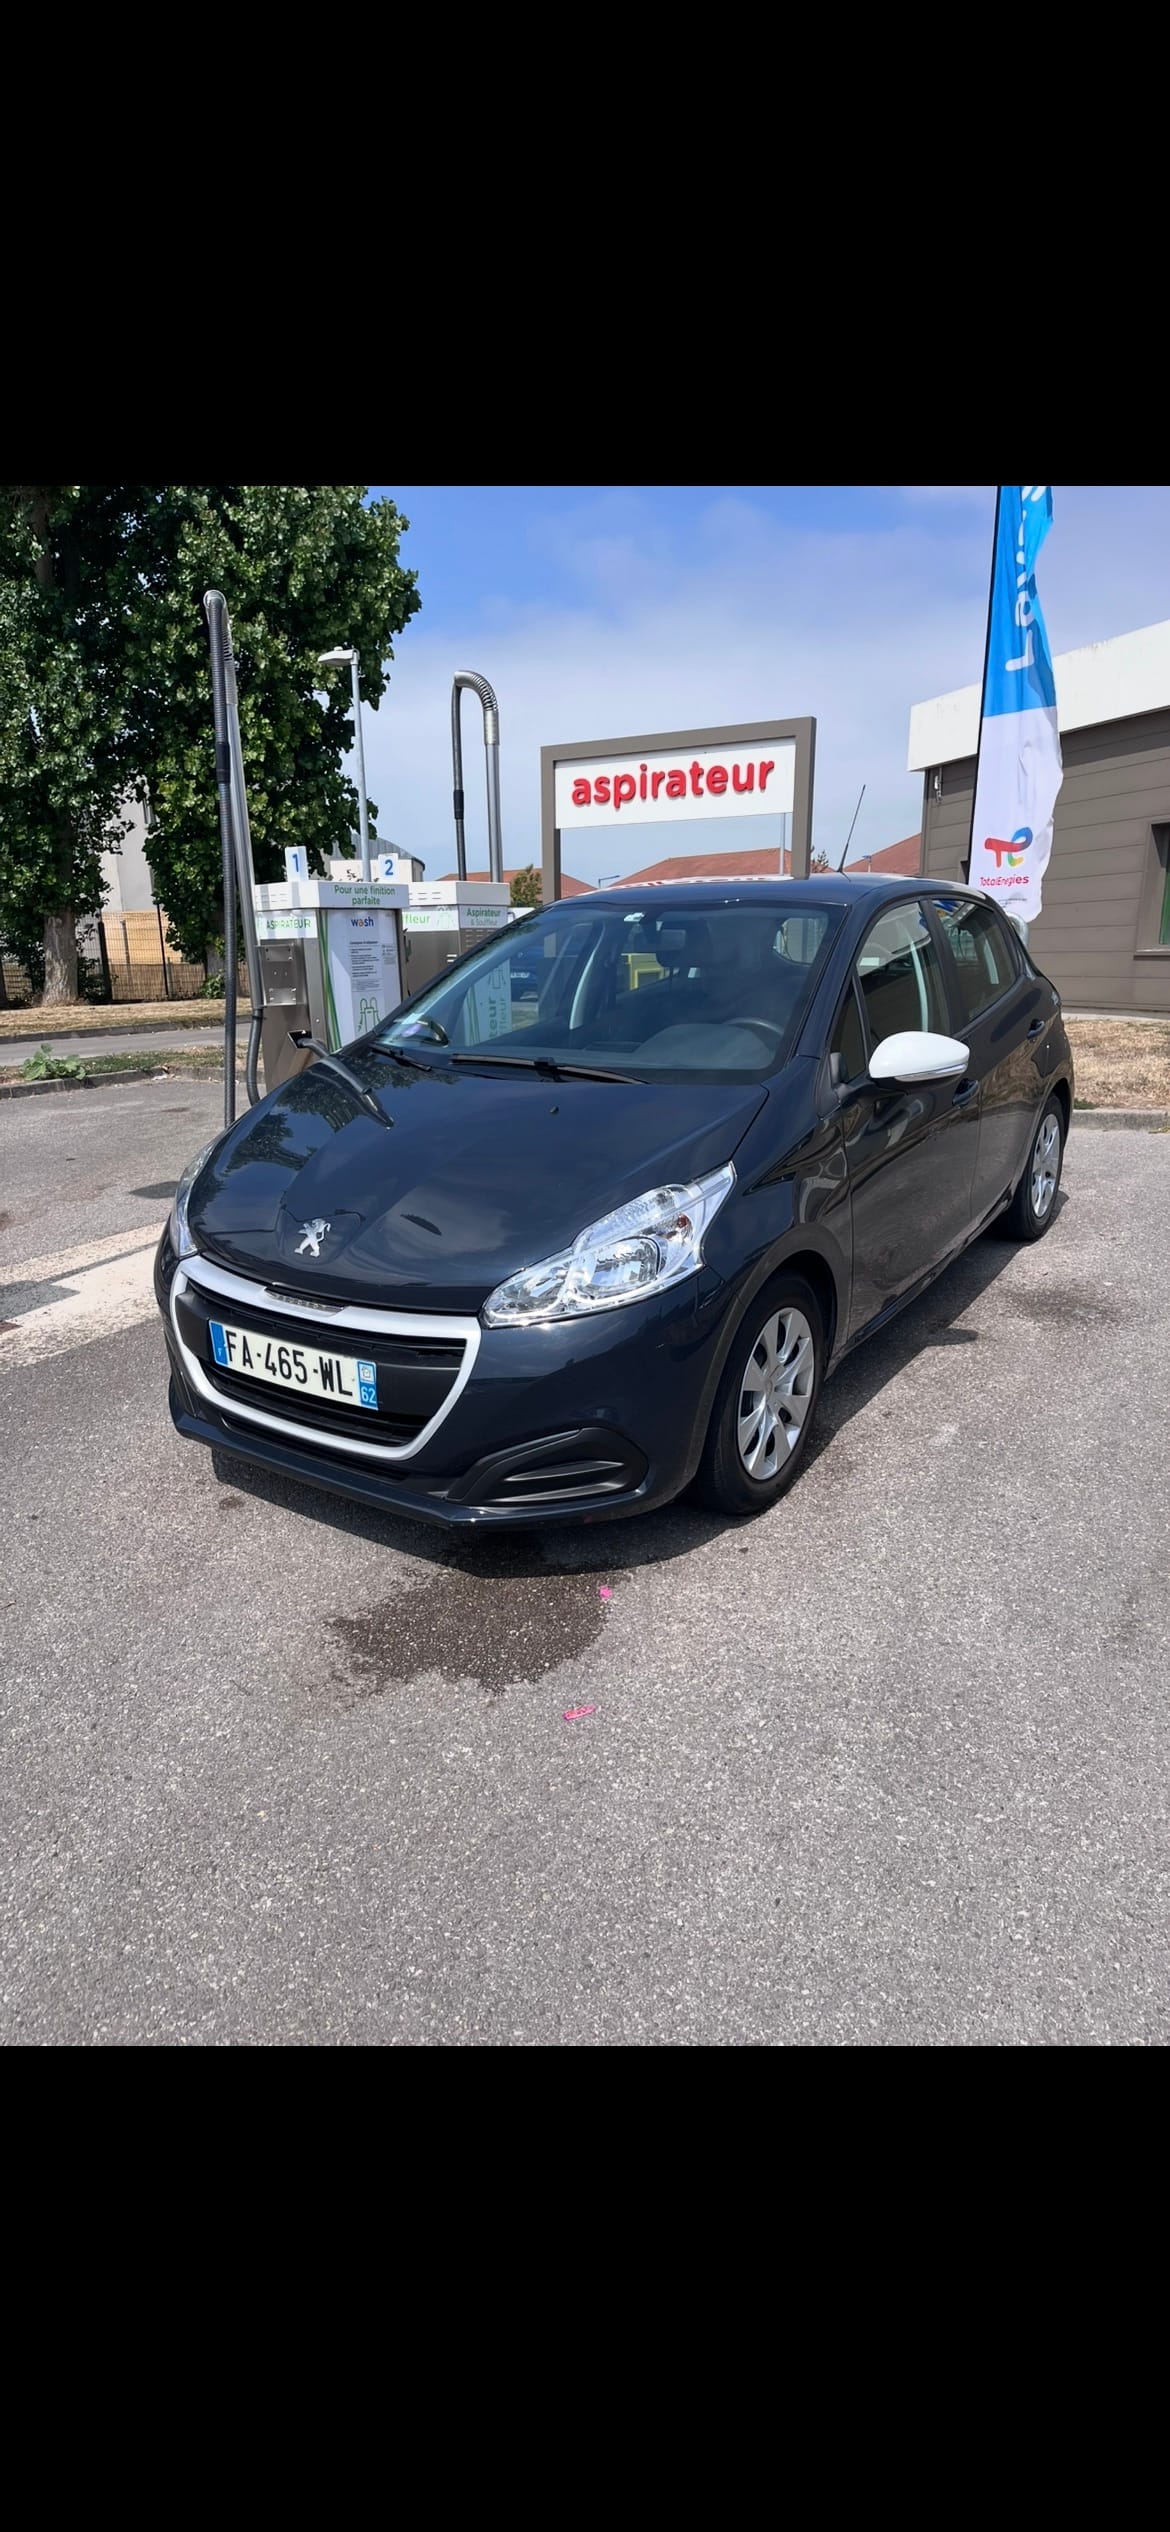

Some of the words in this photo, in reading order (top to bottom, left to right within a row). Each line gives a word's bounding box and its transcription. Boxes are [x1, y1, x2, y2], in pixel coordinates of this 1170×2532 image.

[572, 760, 775, 809] aspirateur
[292, 853, 299, 873] 1
[384, 859, 394, 876] 2
[334, 885, 352, 895] Pour
[354, 886, 368, 895] une
[370, 885, 396, 895] finition
[352, 896, 381, 906] parfaite
[467, 907, 501, 918] Aspirateur
[266, 919, 311, 930] ASPIRATEUR
[224, 1329, 354, 1397] FA-465-WL
[360, 1386, 377, 1404] 62
